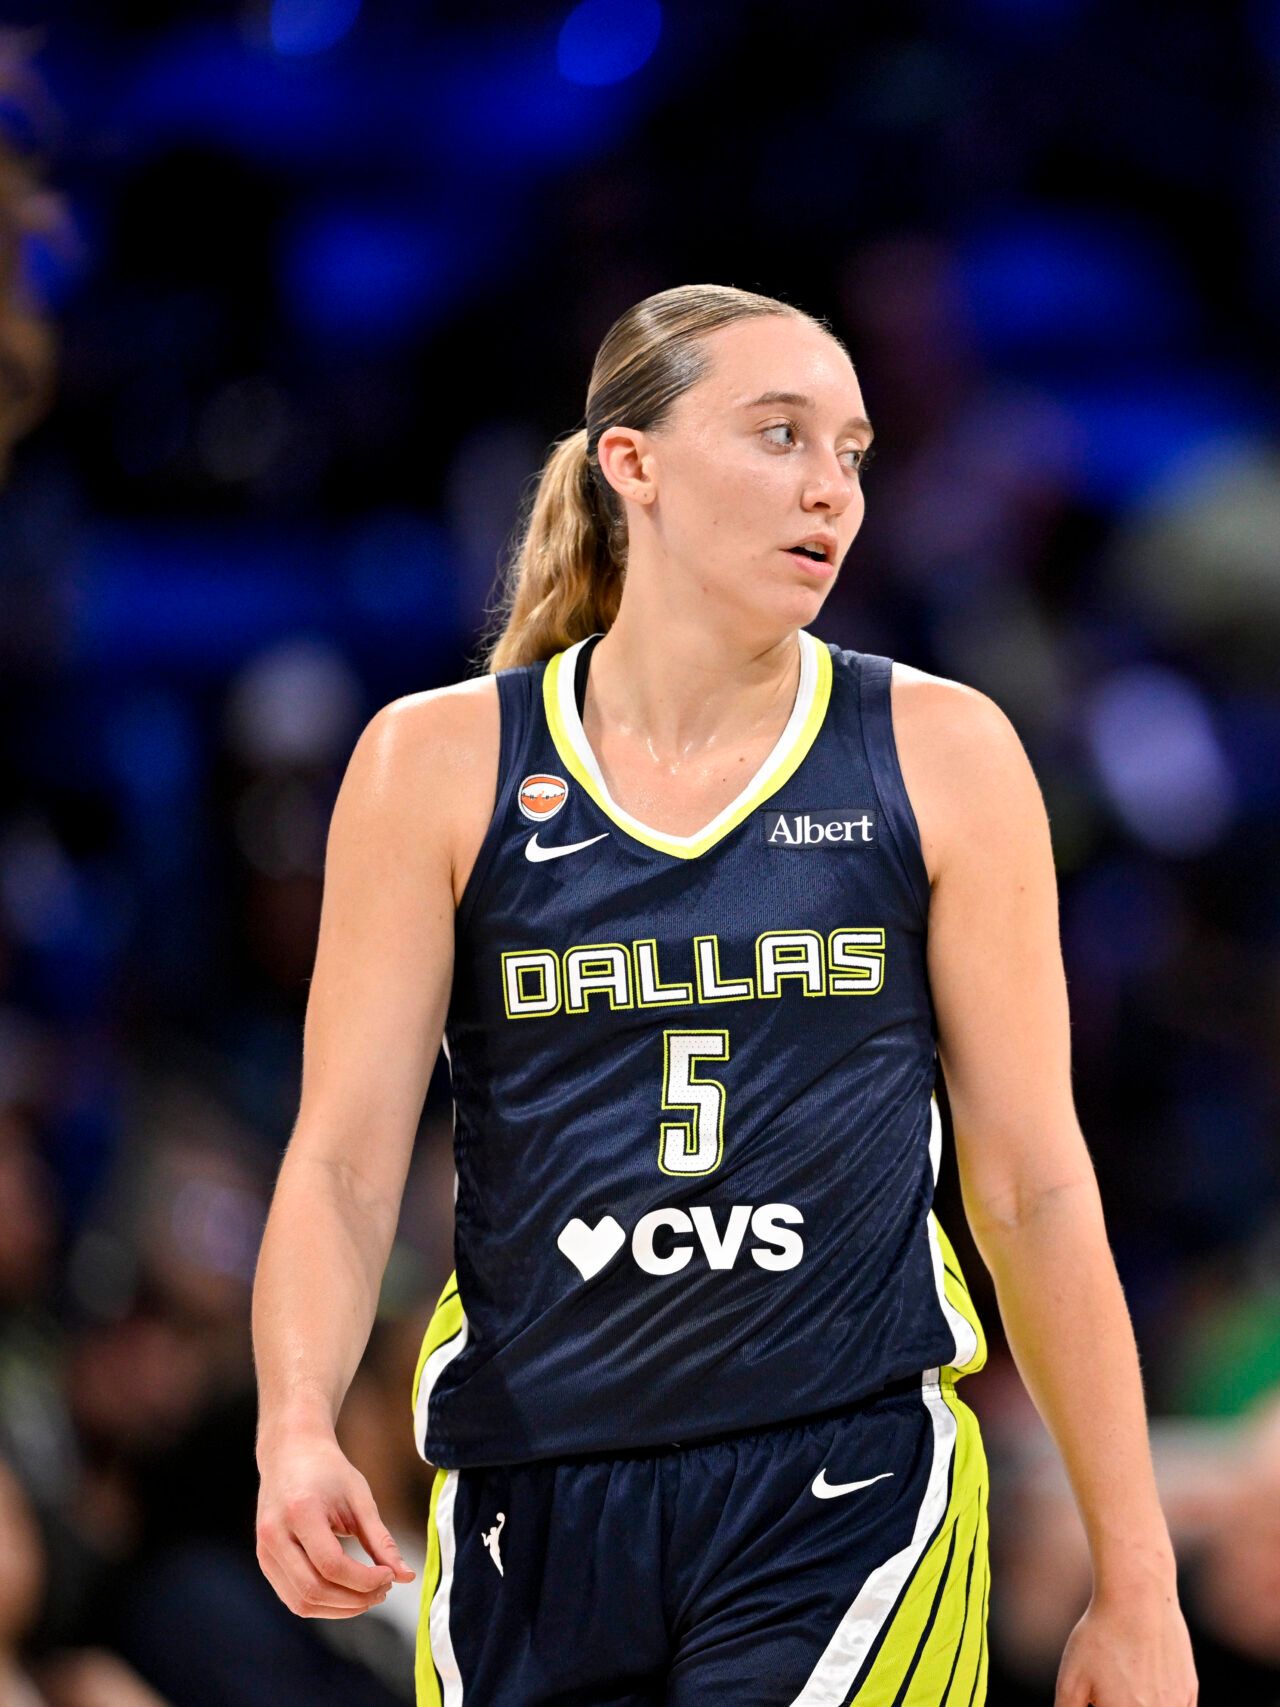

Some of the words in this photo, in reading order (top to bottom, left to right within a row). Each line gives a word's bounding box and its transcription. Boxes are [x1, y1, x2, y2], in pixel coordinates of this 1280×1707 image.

[767, 814, 874, 845] Albert
[500, 927, 886, 1020] DALLAS
[657, 1029, 730, 1177] 5
[631, 1203, 805, 1276] CVS
